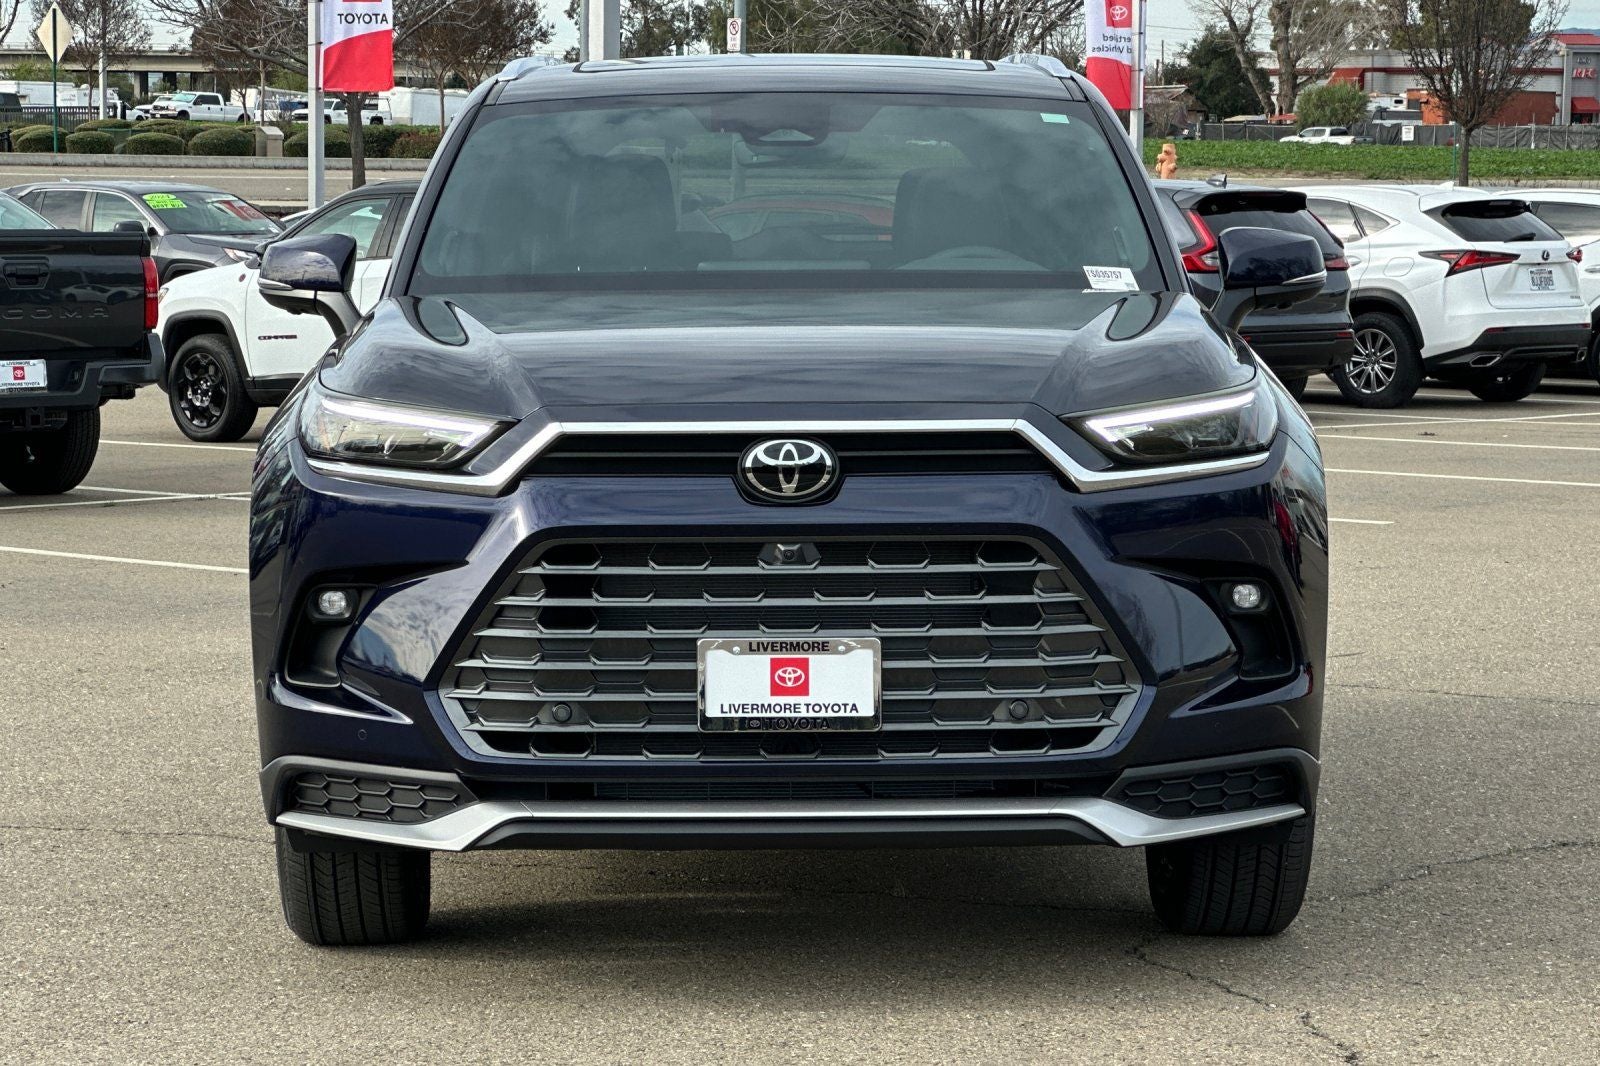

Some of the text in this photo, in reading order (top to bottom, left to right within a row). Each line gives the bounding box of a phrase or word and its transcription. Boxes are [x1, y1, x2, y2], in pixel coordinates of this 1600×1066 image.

[337, 13, 388, 24] TOYOTA
[748, 641, 830, 652] LIVERMORE
[720, 703, 859, 714] LIVERMORE TOYOTA
[766, 717, 830, 730] TOYOTA
